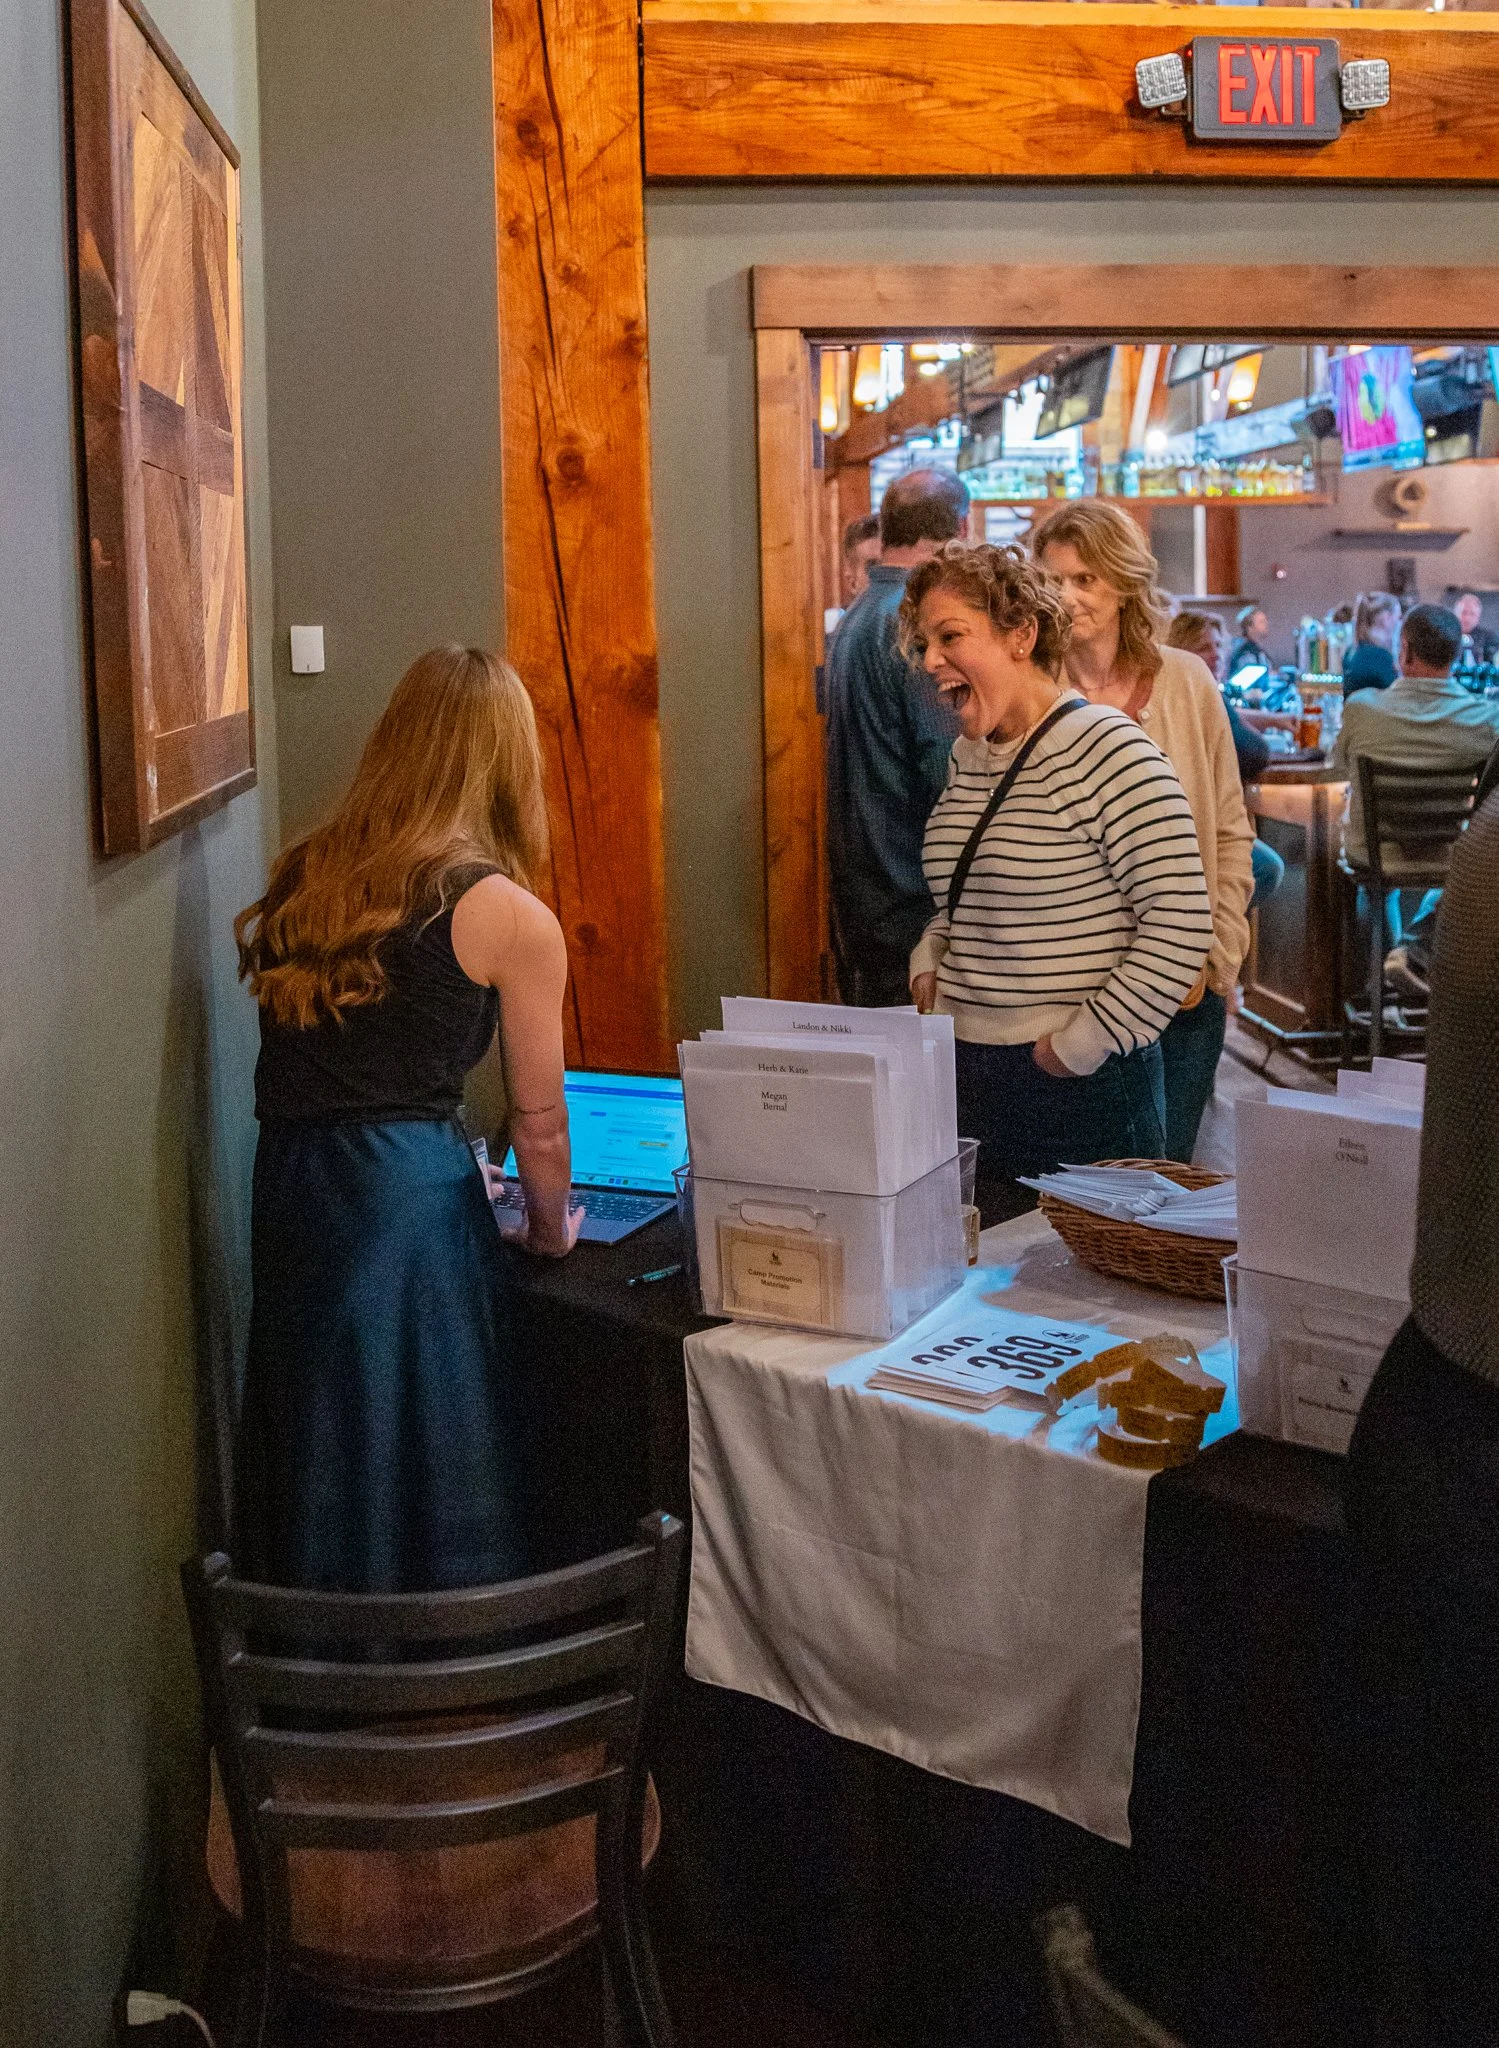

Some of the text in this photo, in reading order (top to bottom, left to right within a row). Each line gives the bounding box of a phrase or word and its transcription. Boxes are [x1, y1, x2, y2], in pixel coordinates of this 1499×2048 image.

[1218, 44, 1320, 125] EXIT
[792, 1021, 820, 1031] Landon
[830, 1024, 852, 1034] Nikki
[758, 1063, 809, 1075] Herb & Katie
[761, 1091, 788, 1102] Megan
[763, 1102, 787, 1112] Bernal
[748, 1268, 767, 1279] Camp
[760, 1279, 791, 1290] Materials
[966, 1335, 1083, 1381] 369
